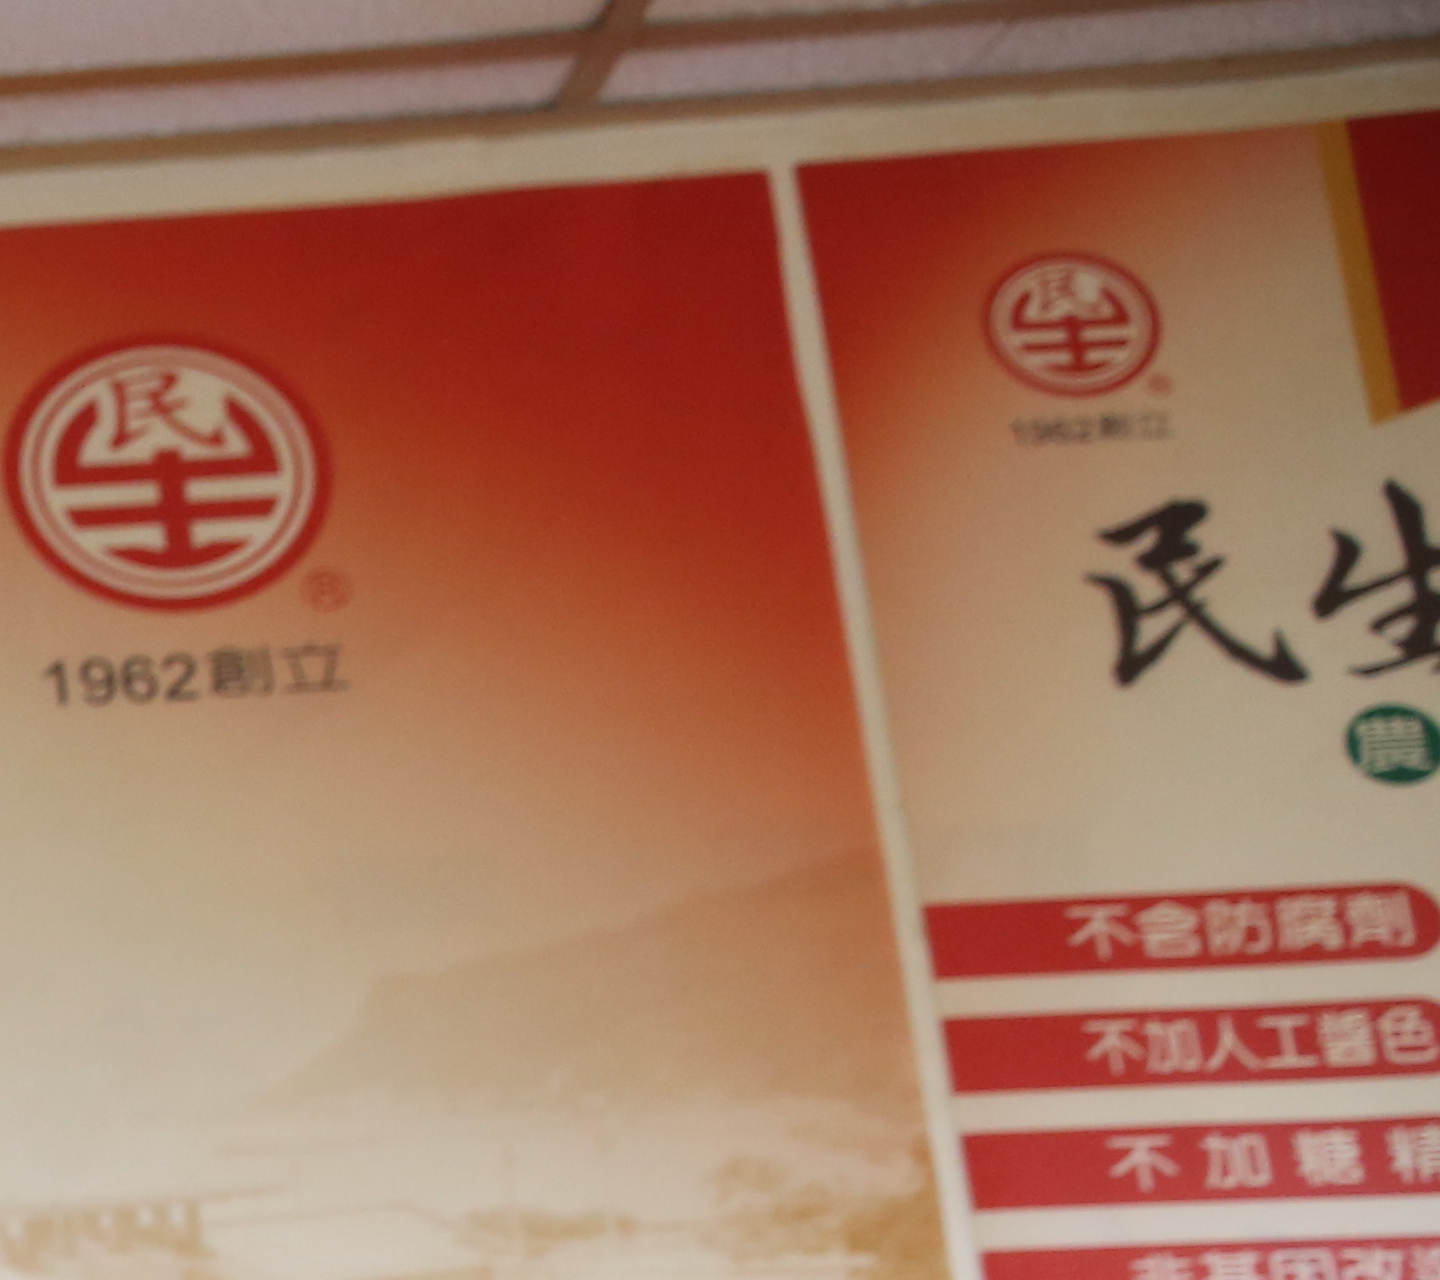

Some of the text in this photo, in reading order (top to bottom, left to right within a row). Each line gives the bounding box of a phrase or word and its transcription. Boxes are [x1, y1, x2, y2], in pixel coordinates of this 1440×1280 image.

[41, 644, 351, 707] 1962創立
[1064, 889, 1418, 961] 不含防腐劑
